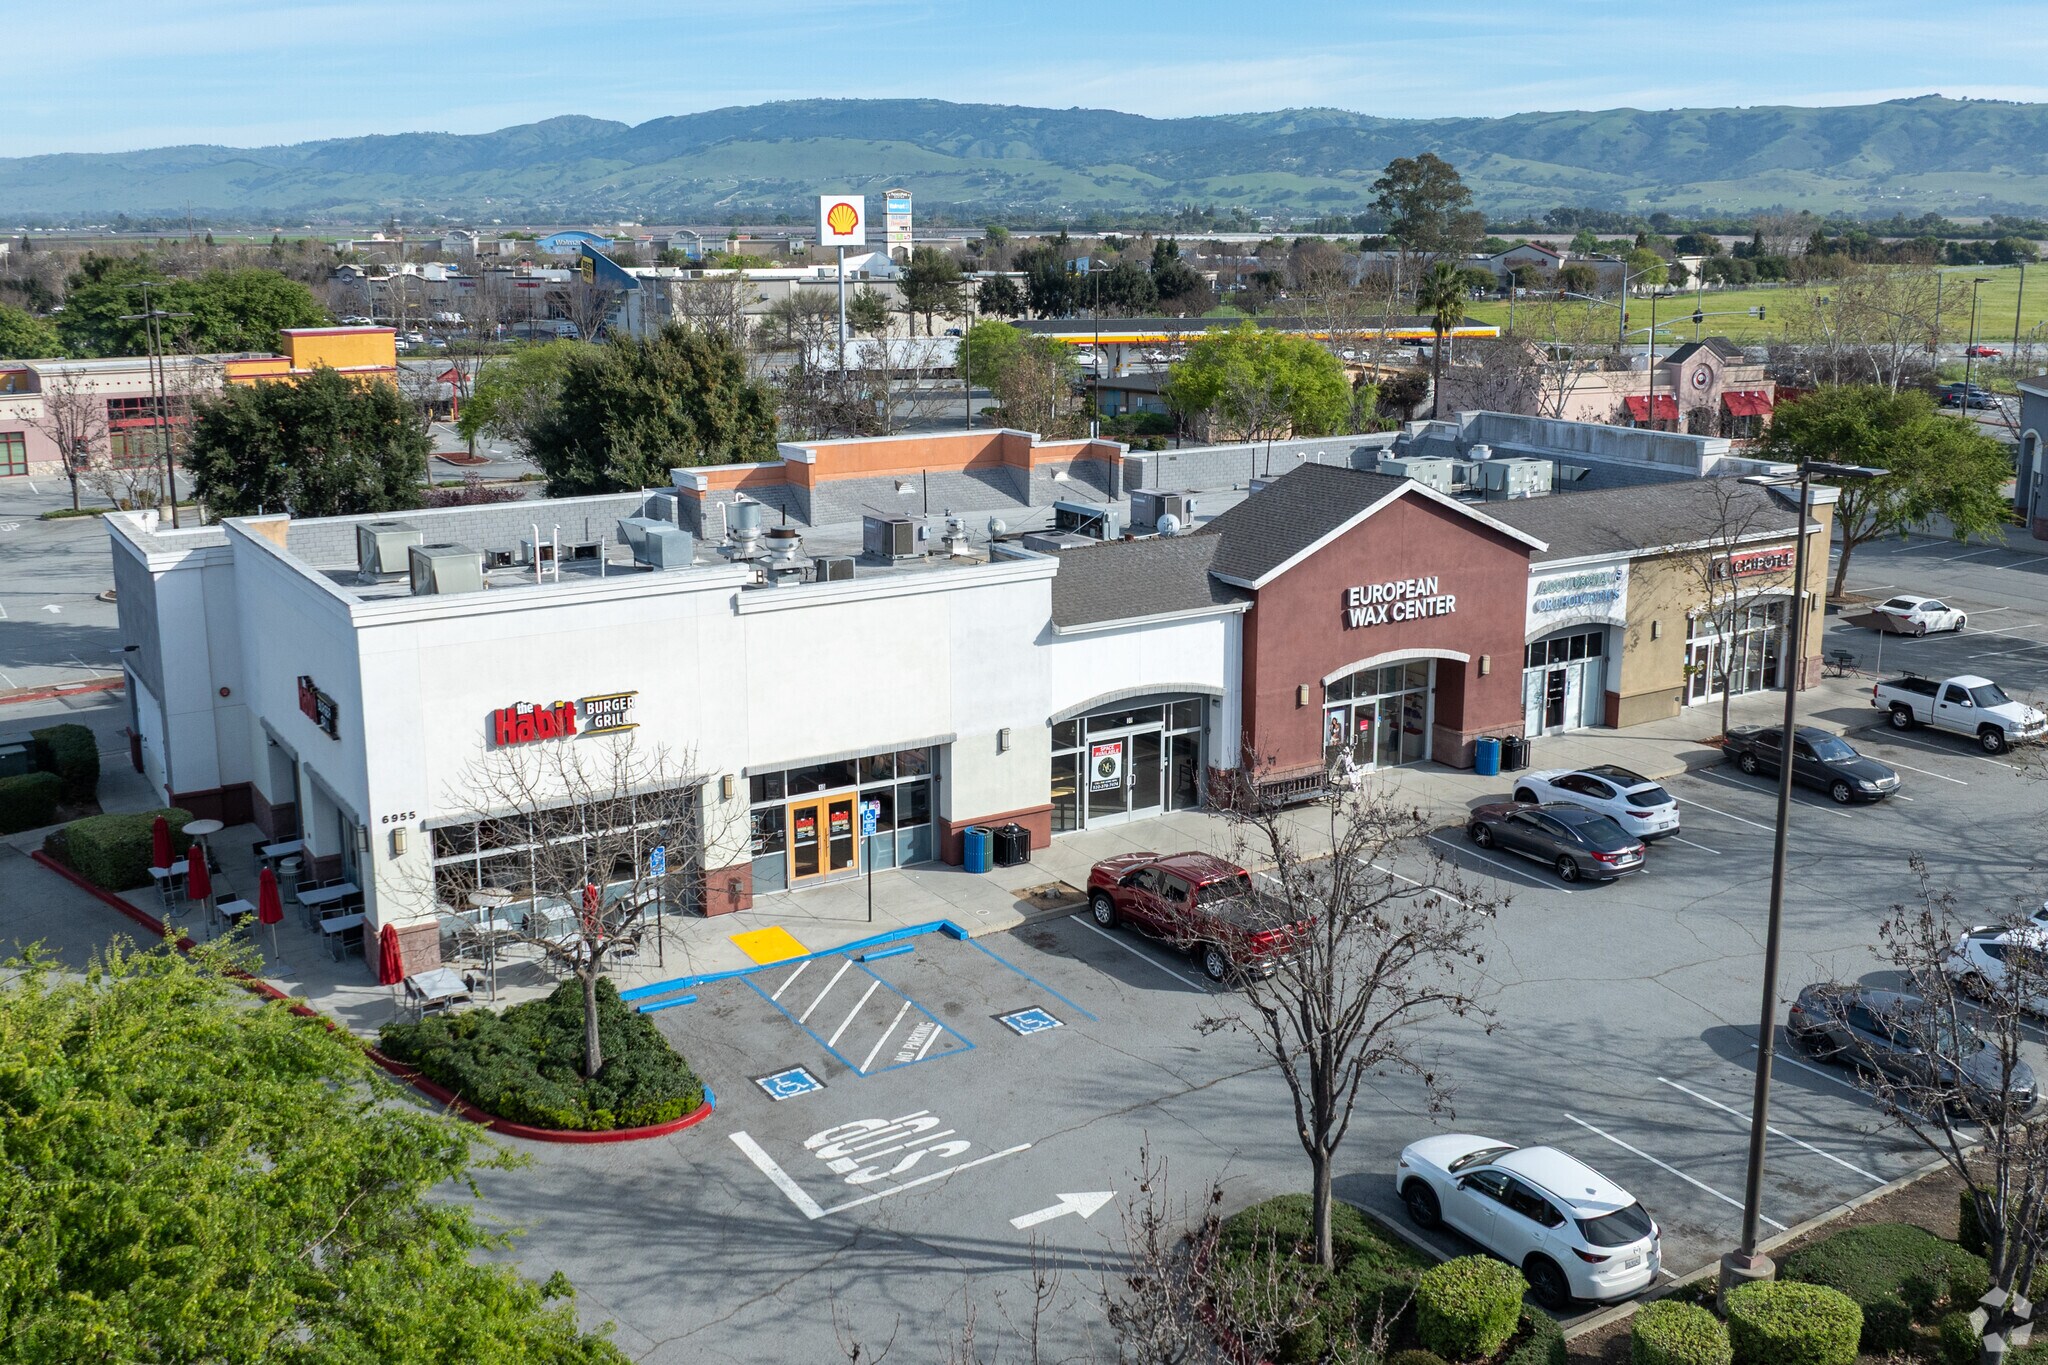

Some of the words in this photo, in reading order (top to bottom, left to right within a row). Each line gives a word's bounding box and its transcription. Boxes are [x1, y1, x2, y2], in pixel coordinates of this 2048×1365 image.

[1735, 553, 1794, 572] CHIPOTLE
[1349, 576, 1438, 606] EUROPEAN
[1348, 604, 1389, 627] WAX
[1391, 594, 1456, 621] CENTER
[516, 703, 533, 714] the
[587, 697, 635, 714] BURGER
[495, 701, 577, 746] Habit
[595, 712, 629, 727] GRILL
[381, 811, 416, 824] 6955
[903, 1022, 935, 1050] PARKING
[894, 1051, 915, 1062] NO
[804, 1110, 971, 1184] STOP
